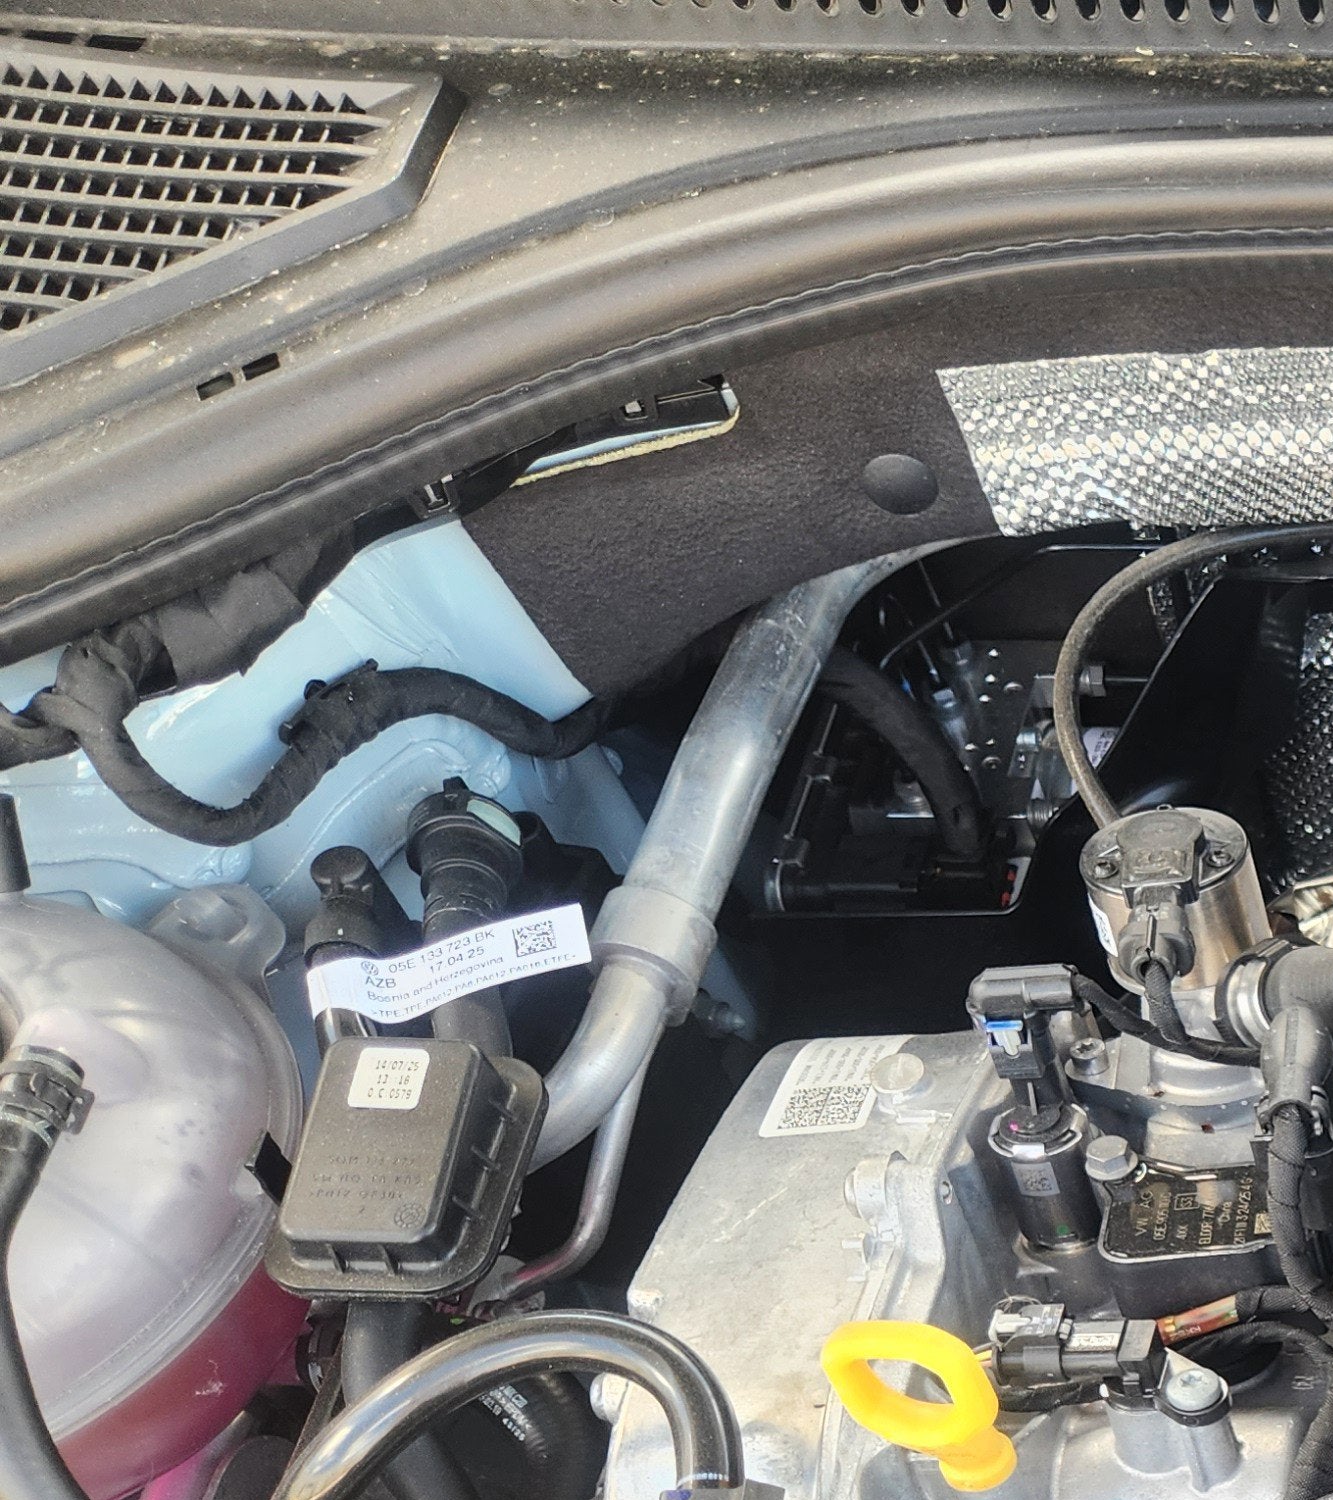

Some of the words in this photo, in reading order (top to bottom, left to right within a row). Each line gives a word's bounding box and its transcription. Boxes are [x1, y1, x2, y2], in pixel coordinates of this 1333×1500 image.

[389, 958, 417, 974] 05E
[420, 947, 442, 964] 133
[447, 936, 471, 953] 723
[474, 928, 496, 943] BK
[364, 976, 397, 989] AZB
[366, 990, 411, 1003] Bosnia
[413, 981, 434, 997] and
[434, 956, 504, 985] Herzegovina
